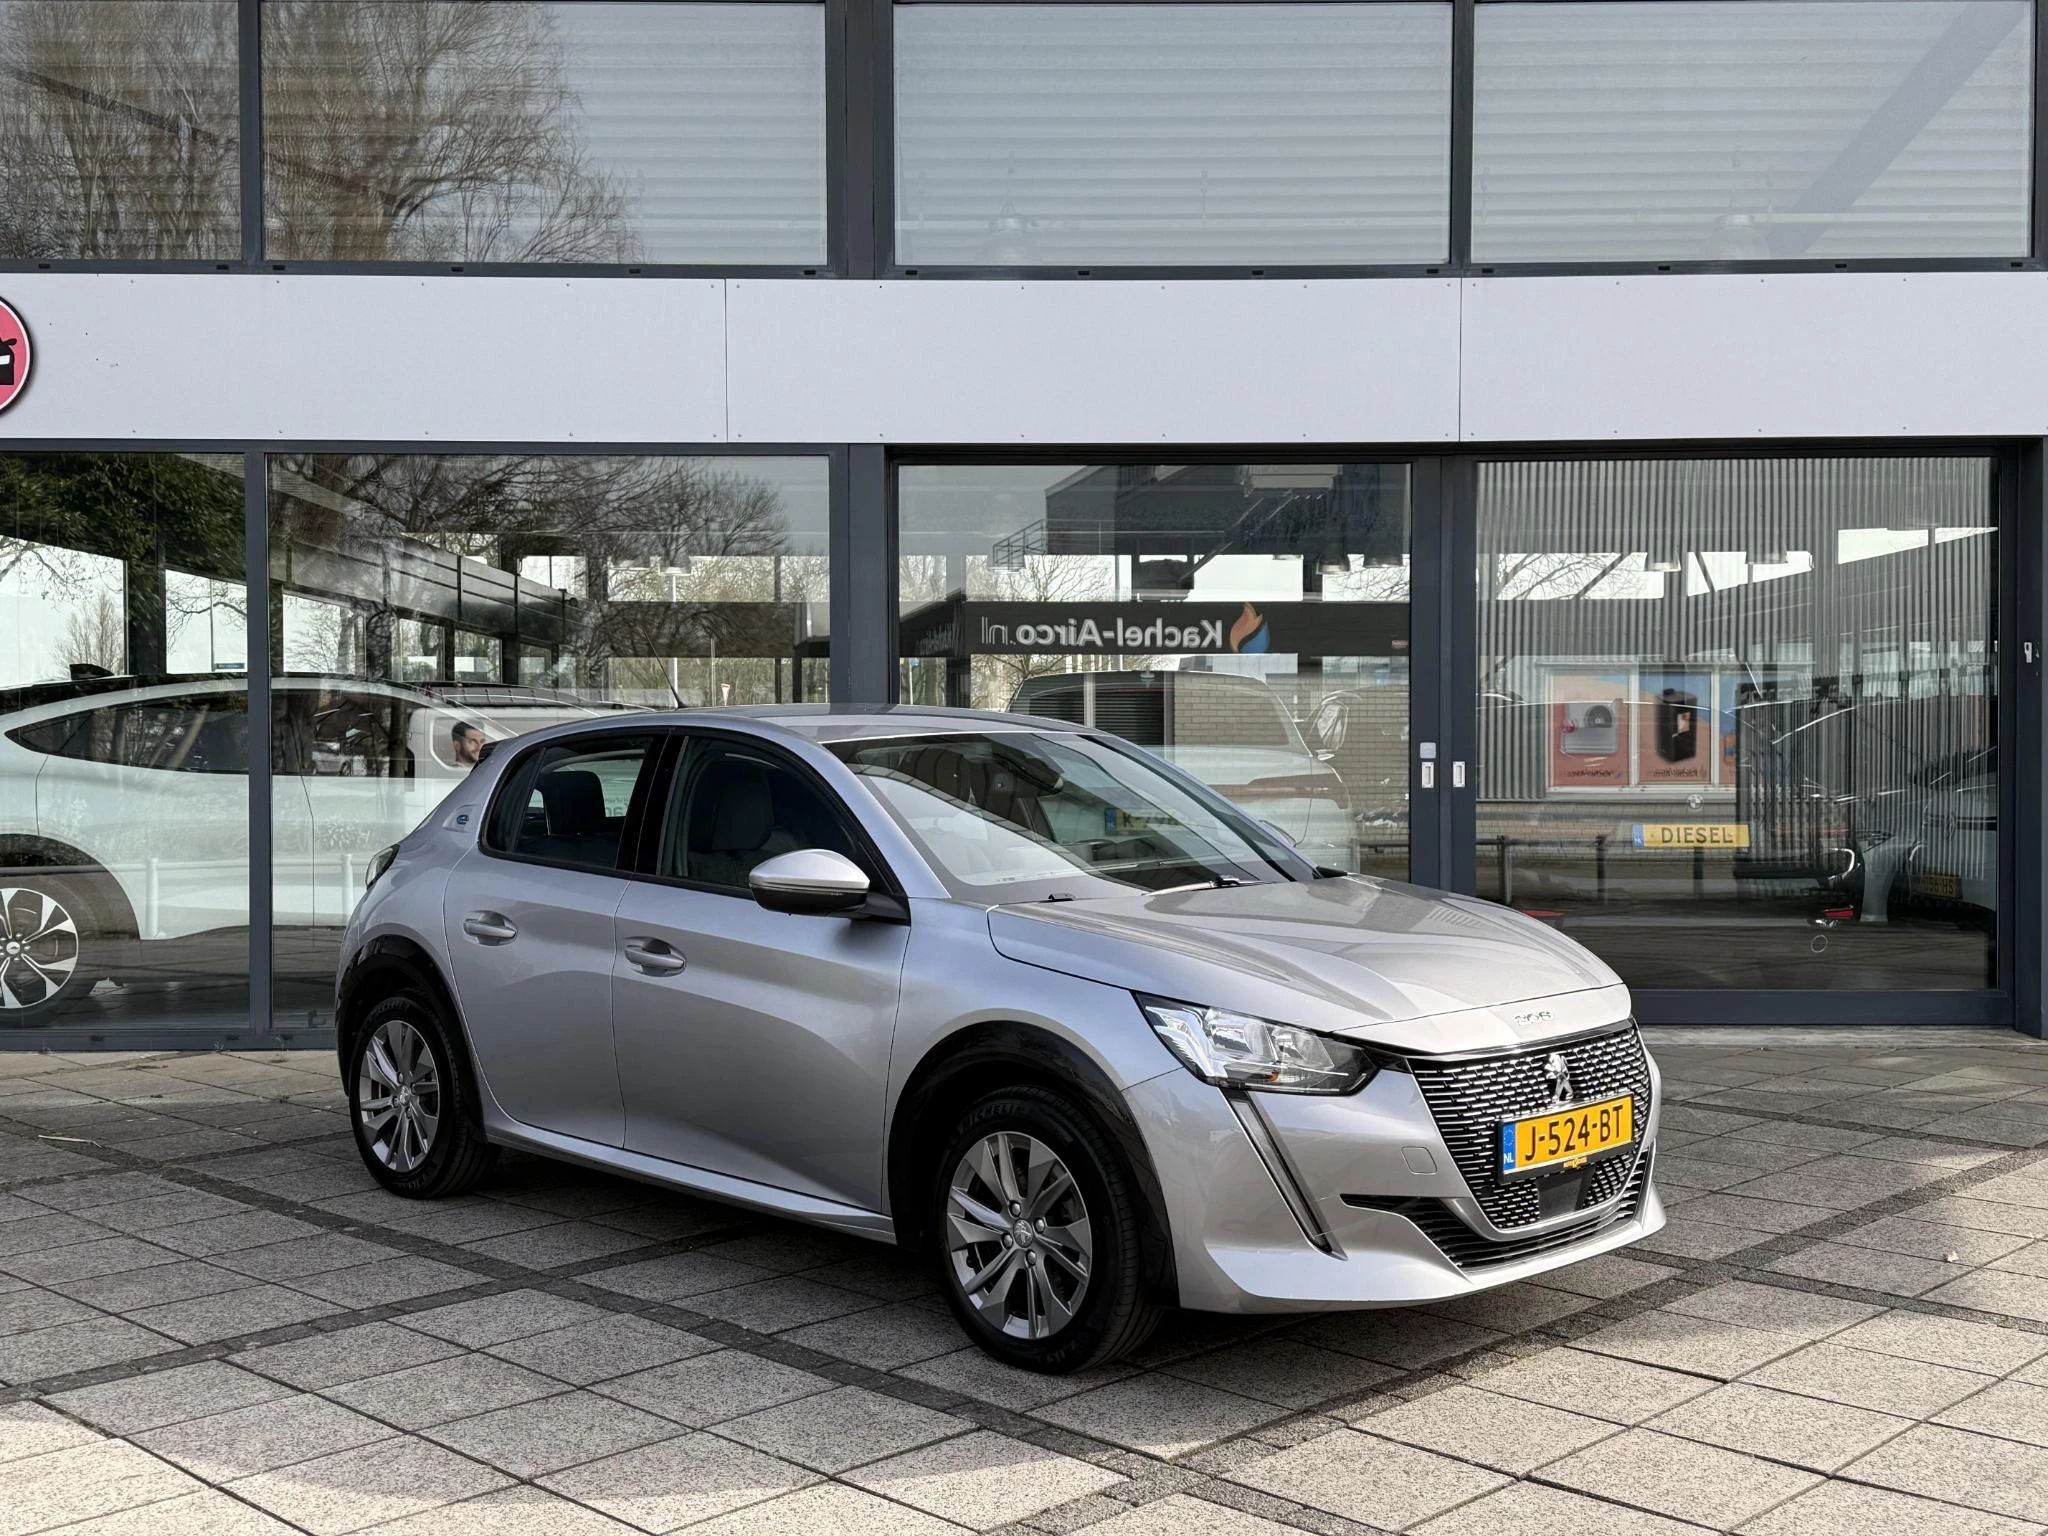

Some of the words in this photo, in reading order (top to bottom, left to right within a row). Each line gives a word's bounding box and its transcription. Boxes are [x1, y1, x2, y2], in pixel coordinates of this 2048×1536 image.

[1661, 826, 1734, 844] DIESEL
[1525, 1104, 1624, 1162] J-524-BT
[1503, 1152, 1514, 1165] NL
